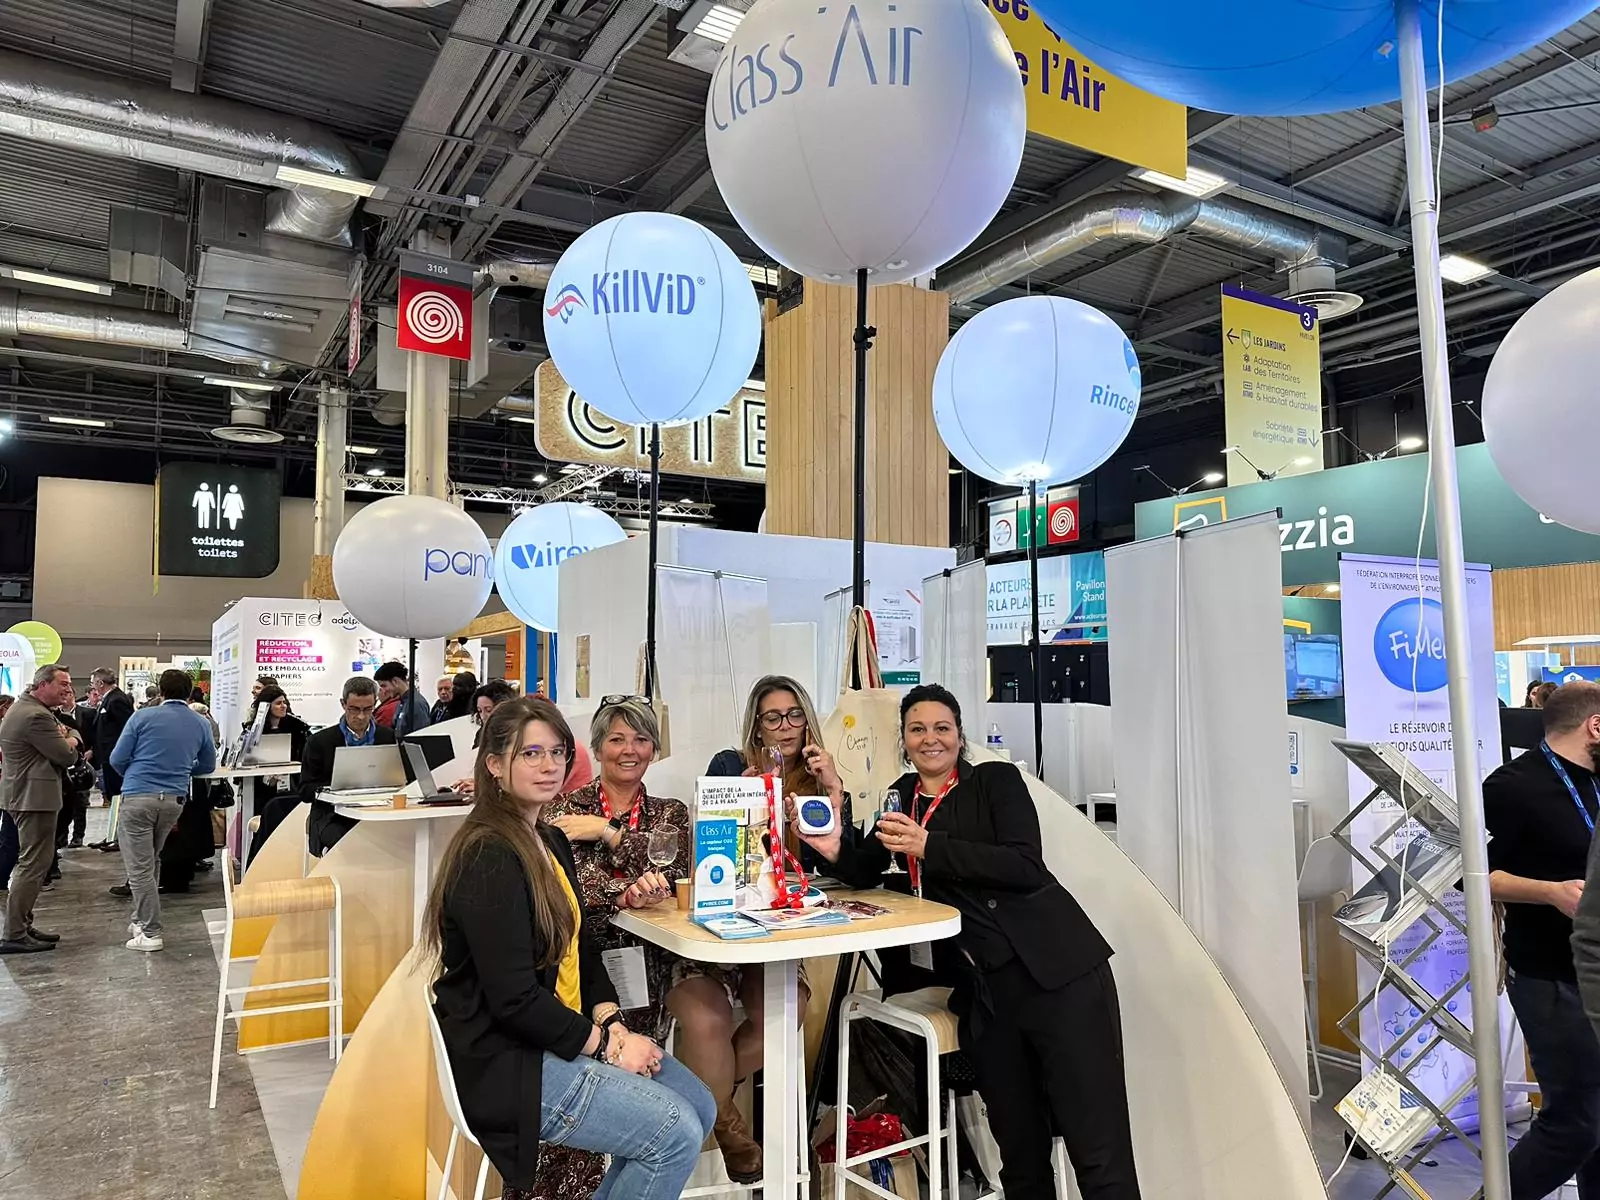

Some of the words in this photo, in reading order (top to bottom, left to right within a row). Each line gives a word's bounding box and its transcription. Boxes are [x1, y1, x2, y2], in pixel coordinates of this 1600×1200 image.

[712, 34, 803, 131] Class
[427, 263, 448, 274] 3104
[1303, 312, 1311, 327] 3
[1253, 336, 1263, 347] LES
[1263, 339, 1286, 352] JARDINS
[1253, 355, 1291, 371] Adaptation
[1254, 367, 1267, 377] des
[1268, 369, 1301, 384] Territoires
[1262, 394, 1288, 407] Habitat
[1289, 399, 1318, 412] durables
[191, 536, 244, 547] toilettes
[198, 548, 238, 558] toilets
[1389, 572, 1440, 582] INTERPROFESIONNE
[1076, 579, 1105, 591] Pavillon
[1083, 590, 1104, 601] Stand
[995, 598, 1008, 612] LA
[1010, 592, 1055, 610] PLAÈTE
[331, 615, 360, 626] adelp
[259, 640, 309, 648] RÉDUCTION,
[259, 648, 299, 656] RÉEMPLOI
[275, 665, 326, 673] EMBALLAGES
[1389, 723, 1399, 734] LE
[1401, 720, 1446, 734] RÉSERVOIR
[1418, 739, 1452, 753] QUALITÉ
[700, 824, 719, 836] Class
